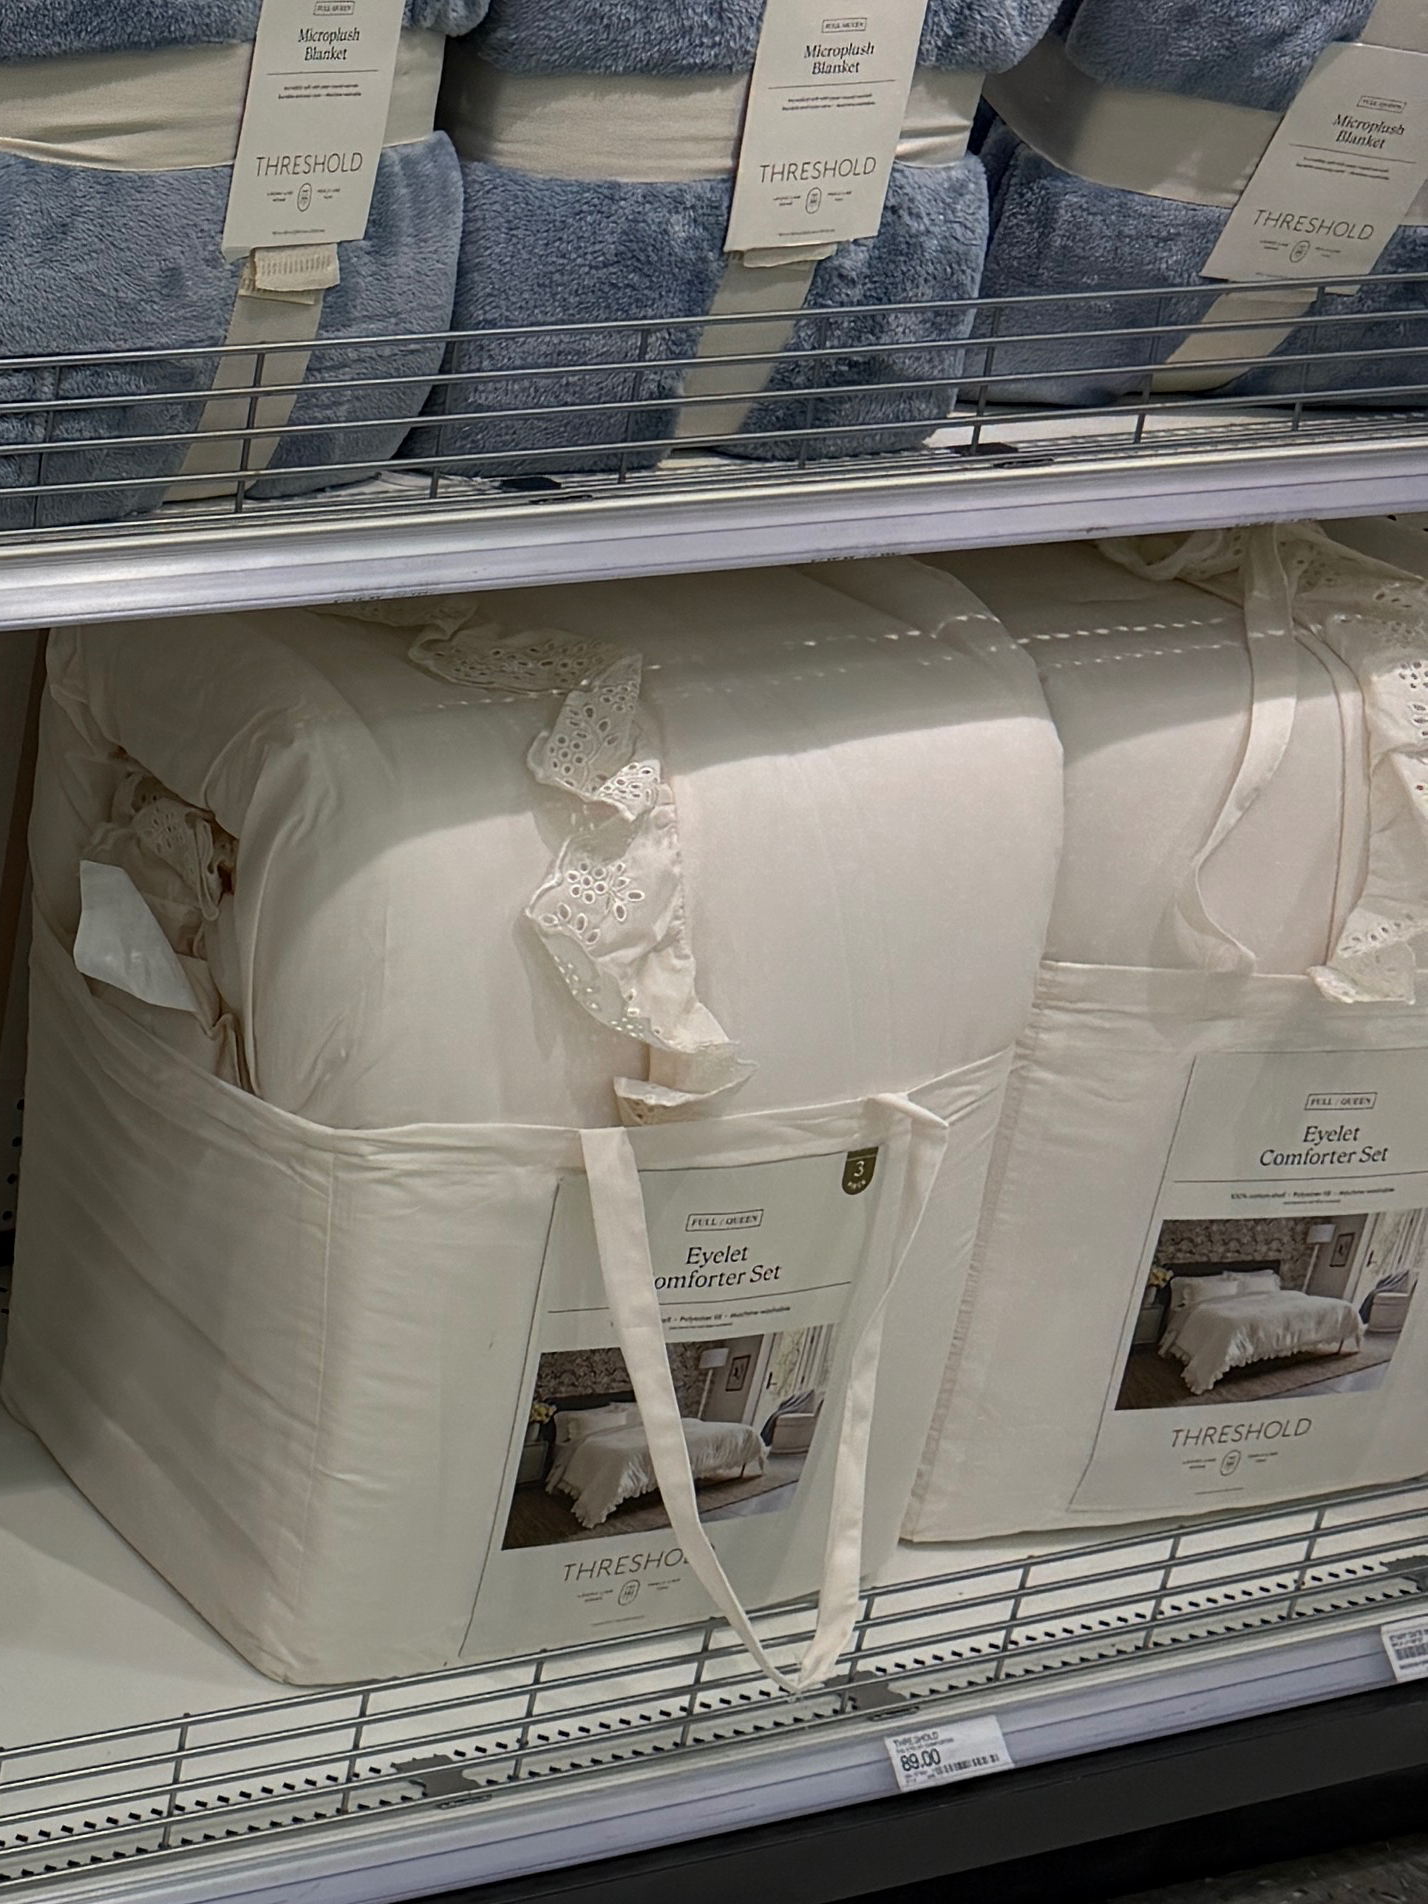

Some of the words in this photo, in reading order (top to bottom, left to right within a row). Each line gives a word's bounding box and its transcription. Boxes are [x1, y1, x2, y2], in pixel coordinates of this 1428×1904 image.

[298, 27, 360, 44] Microplush
[305, 46, 347, 61] Blanket
[804, 41, 875, 59] Microplush
[812, 60, 860, 75] Blanket
[1333, 114, 1405, 135] Microplush
[1335, 130, 1385, 149] Blanket
[256, 152, 363, 176] THRESHOLD
[760, 157, 876, 183] THRESHOLD
[1254, 209, 1374, 240] THRESHOLD
[1302, 1125, 1360, 1146] Eyelet
[1260, 1147, 1356, 1166] Comforter
[1359, 1146, 1389, 1163] Set
[854, 1160, 865, 1177] 3
[686, 1245, 749, 1268] Eyelet
[654, 1270, 746, 1290] omforter
[749, 1264, 782, 1283] Set
[1172, 1418, 1312, 1447] THRESHOLD
[564, 1548, 690, 1582] THRESHO
[900, 1748, 941, 1771] 89.00
